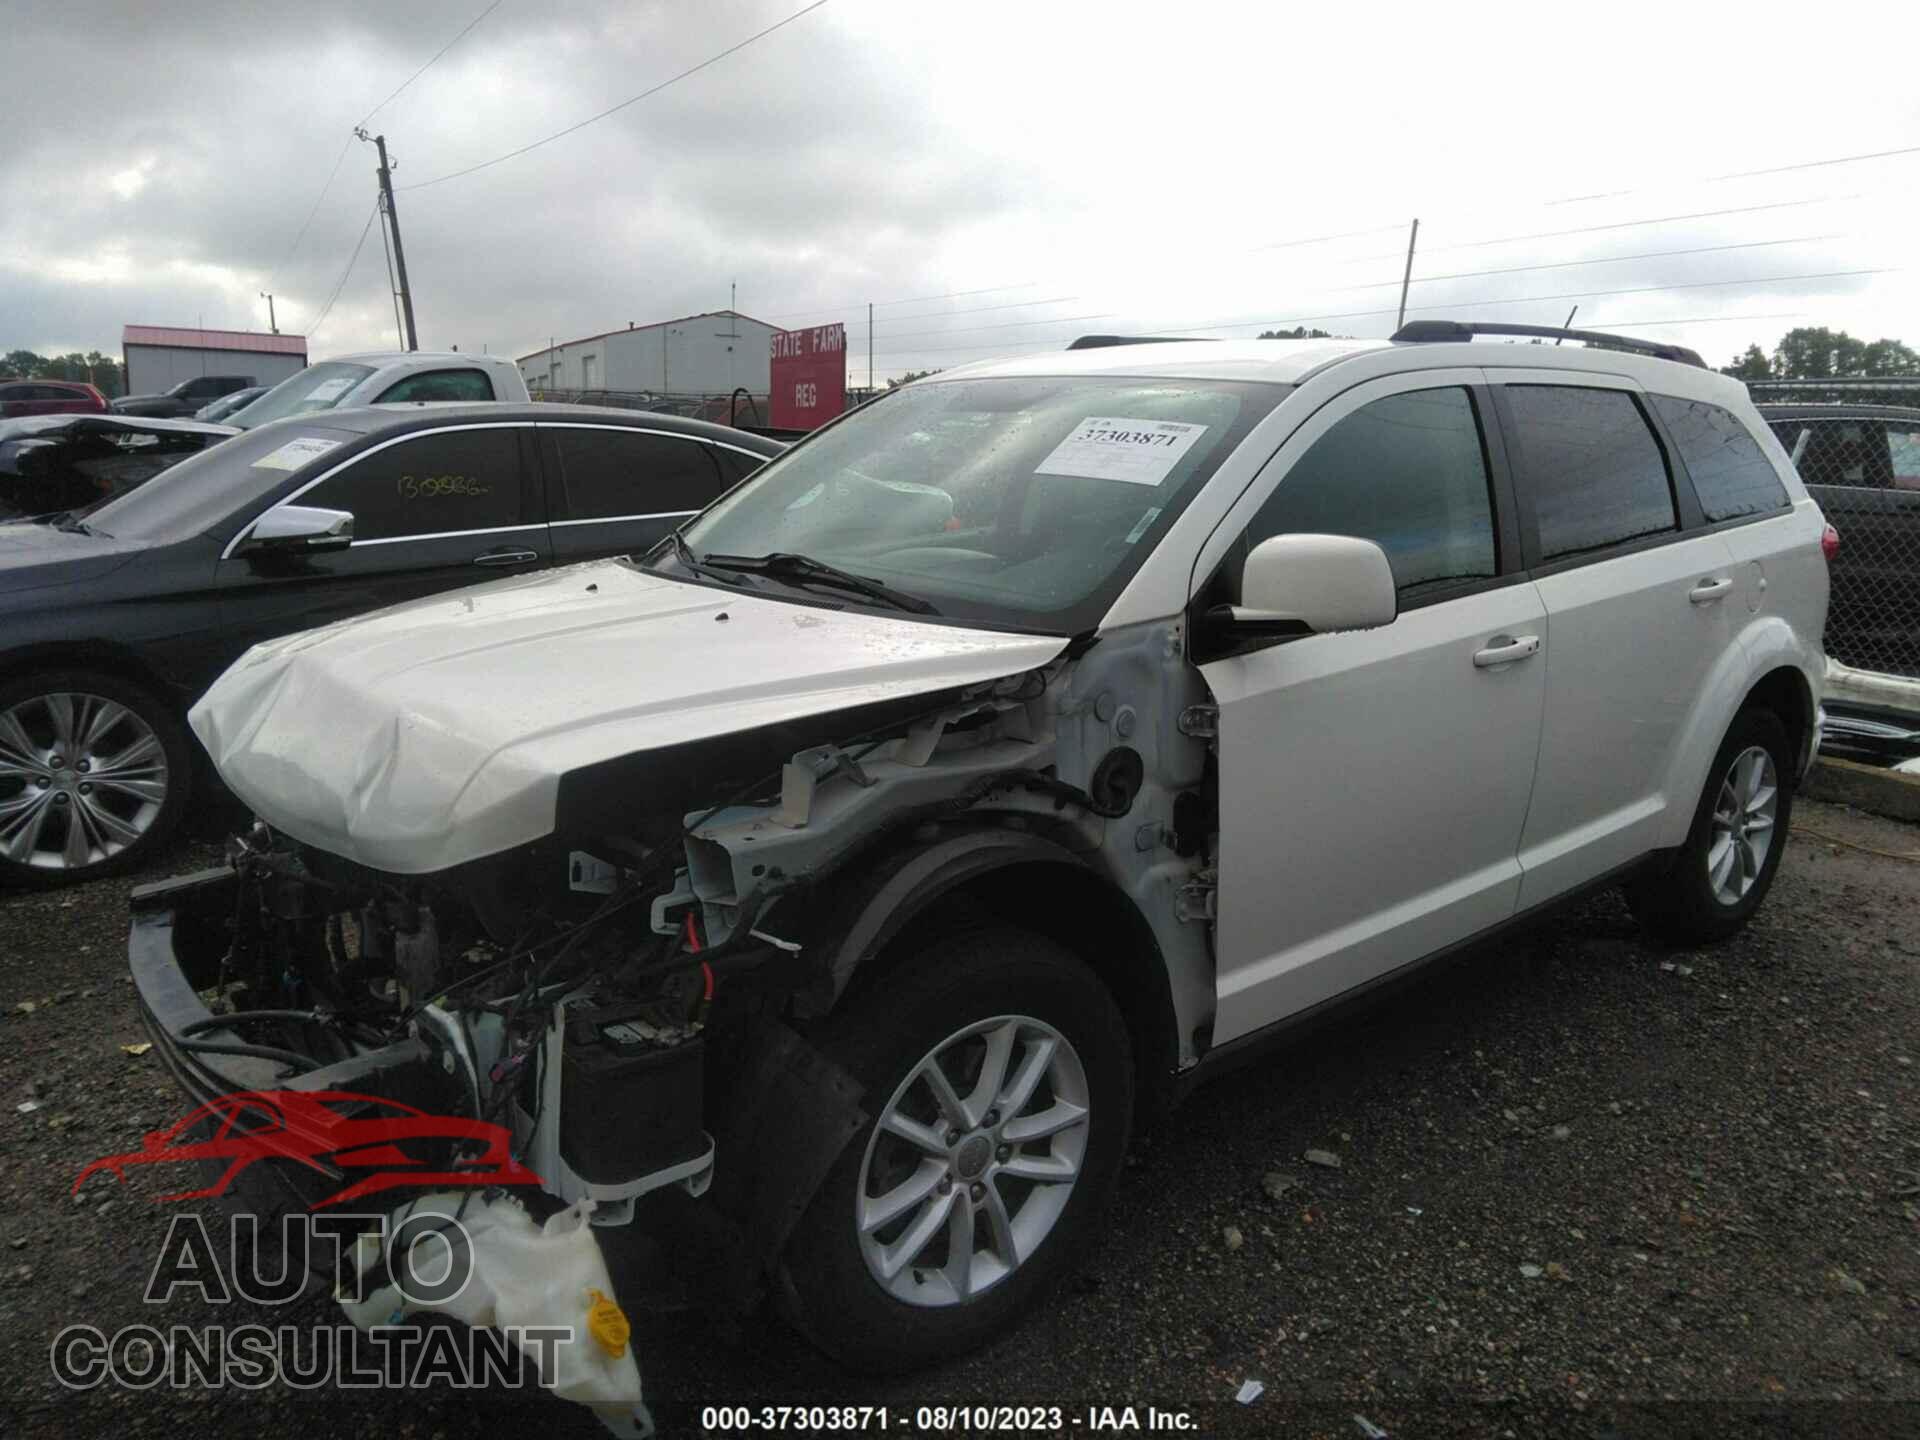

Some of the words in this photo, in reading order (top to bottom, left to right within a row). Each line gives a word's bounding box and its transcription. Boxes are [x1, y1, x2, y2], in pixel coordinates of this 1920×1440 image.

[770, 331, 802, 359] STATE
[812, 325, 843, 353] FARM
[1078, 428, 1177, 447] 37303871
